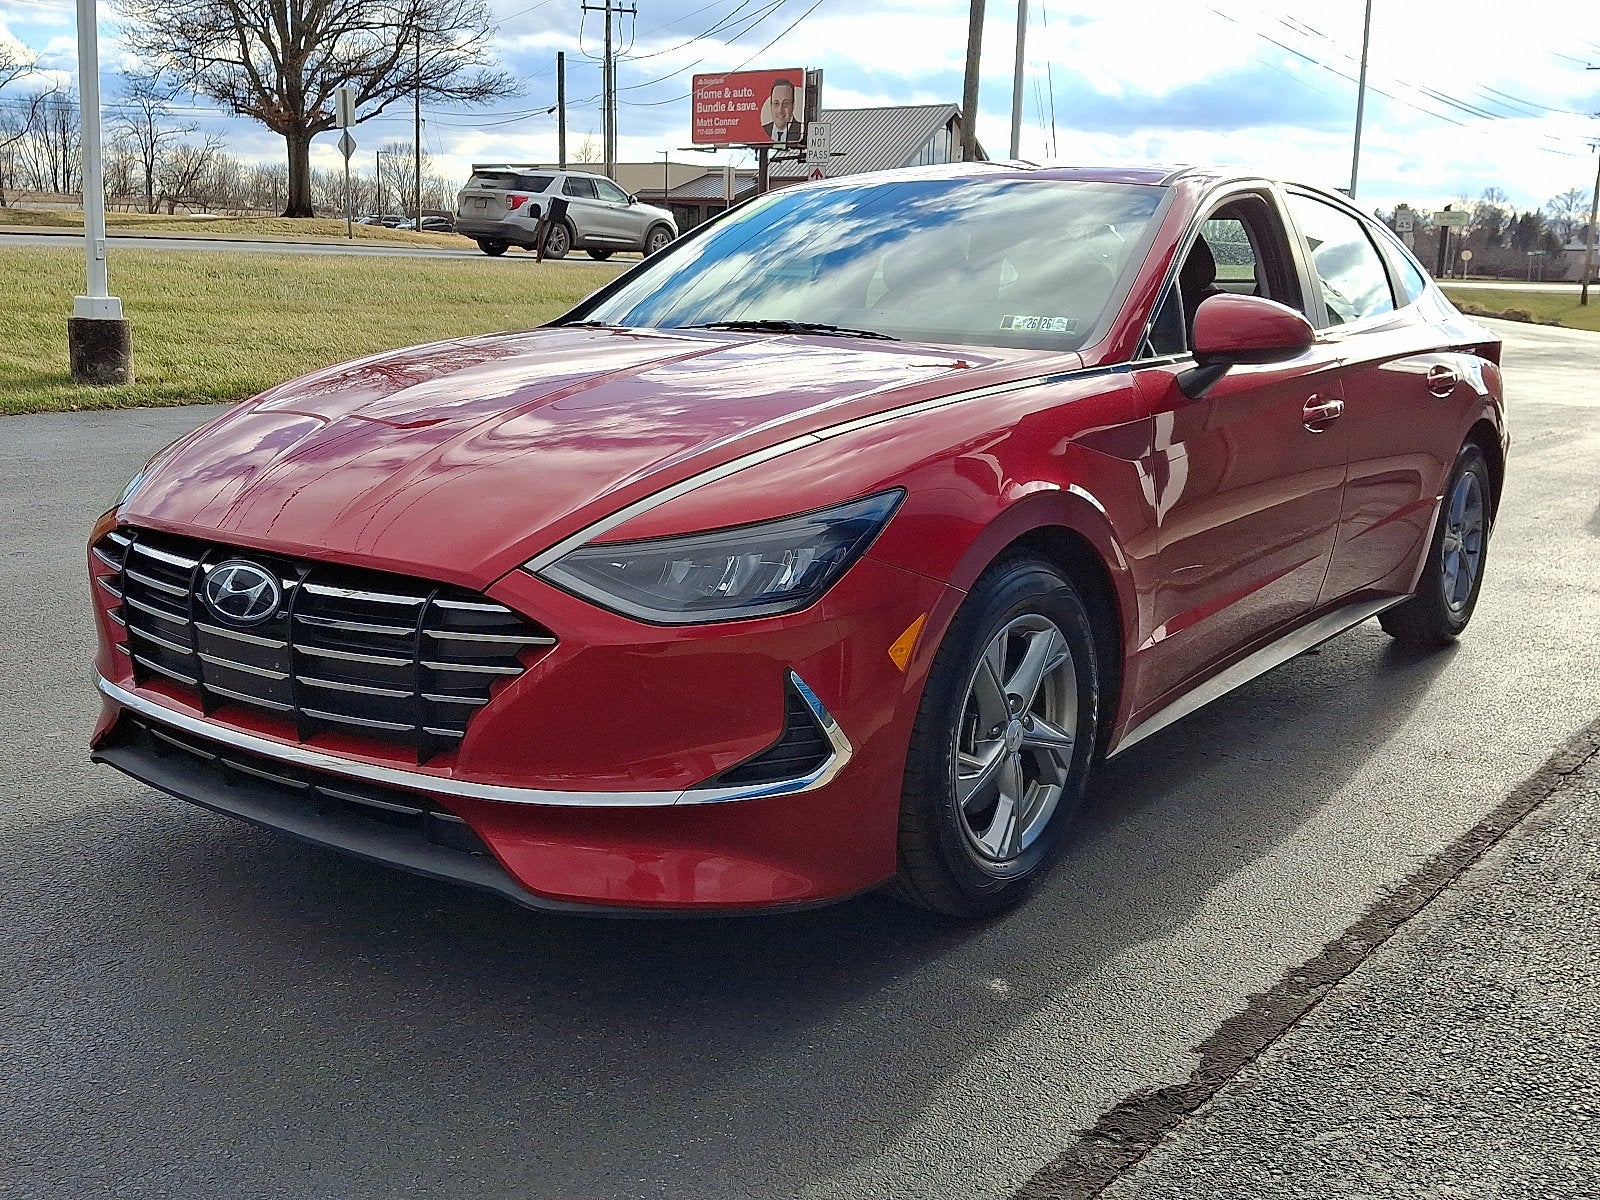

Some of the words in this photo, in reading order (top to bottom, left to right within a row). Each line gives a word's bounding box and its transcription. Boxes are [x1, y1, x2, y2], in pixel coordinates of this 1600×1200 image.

[697, 88, 722, 99] Home
[724, 87, 731, 98] &
[733, 86, 755, 98] auto.
[696, 101, 726, 113] Bundle
[727, 100, 735, 112] &
[736, 102, 759, 111] save.
[696, 118, 713, 127] Matt
[714, 117, 740, 126] Conner
[814, 126, 825, 136] DO
[811, 138, 826, 148] NOT
[808, 150, 828, 160] PASS
[1026, 318, 1038, 329] 26
[1041, 318, 1053, 329] 26
